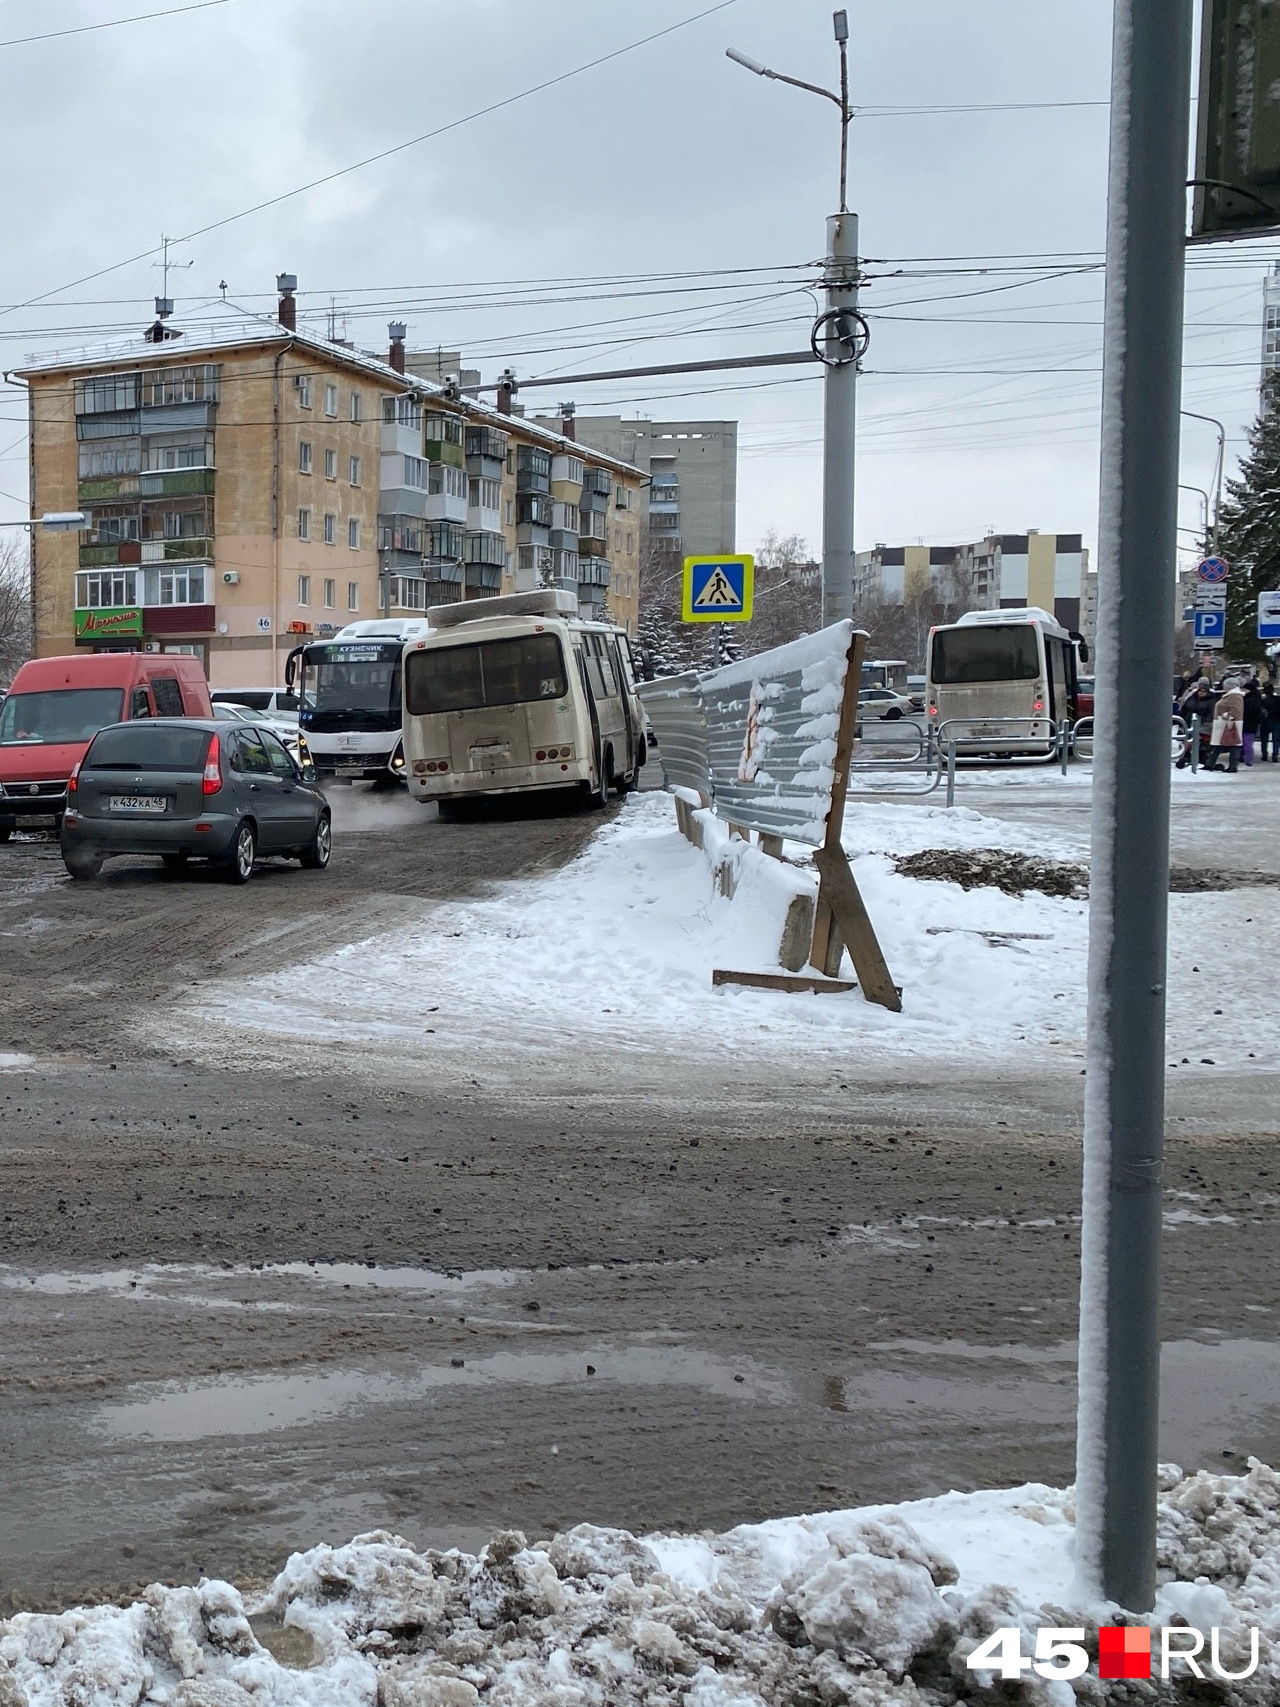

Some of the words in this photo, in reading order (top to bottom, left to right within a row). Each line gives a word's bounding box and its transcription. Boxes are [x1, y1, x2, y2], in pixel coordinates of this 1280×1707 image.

[258, 618, 270, 627] 46
[1200, 614, 1218, 635] P
[542, 680, 556, 695] 24
